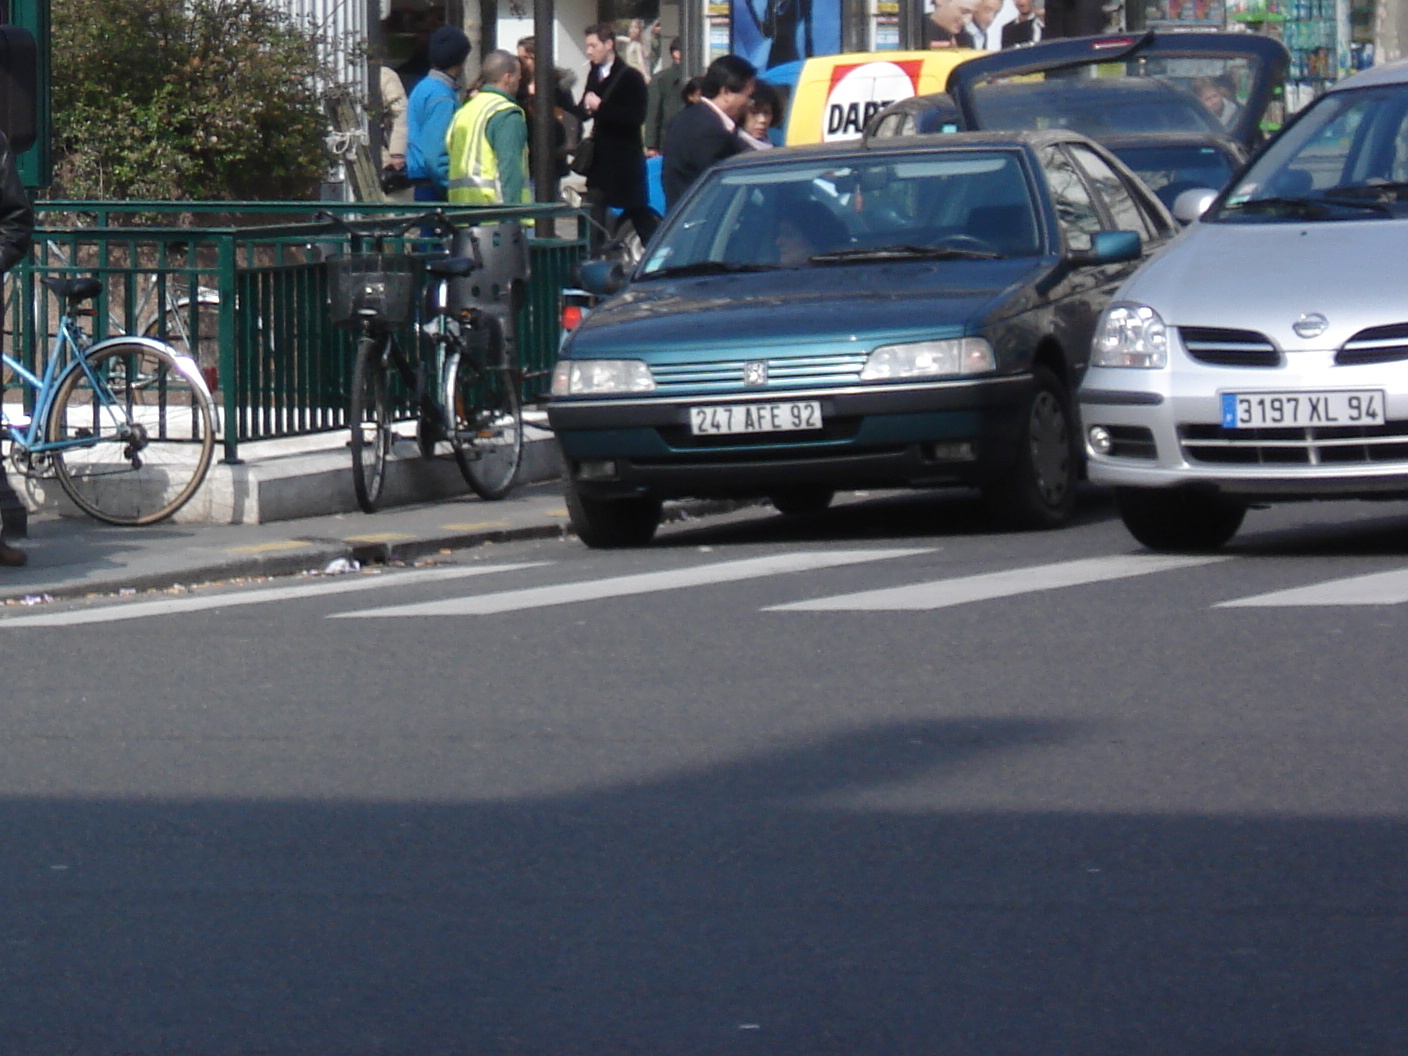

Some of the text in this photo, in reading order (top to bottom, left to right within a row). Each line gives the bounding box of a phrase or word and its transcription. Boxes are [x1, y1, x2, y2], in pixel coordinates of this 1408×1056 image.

[696, 404, 816, 433] 247 AFE 92
[1238, 397, 1300, 423] 3197
[1308, 396, 1339, 423] XL
[1348, 395, 1379, 421] 94
